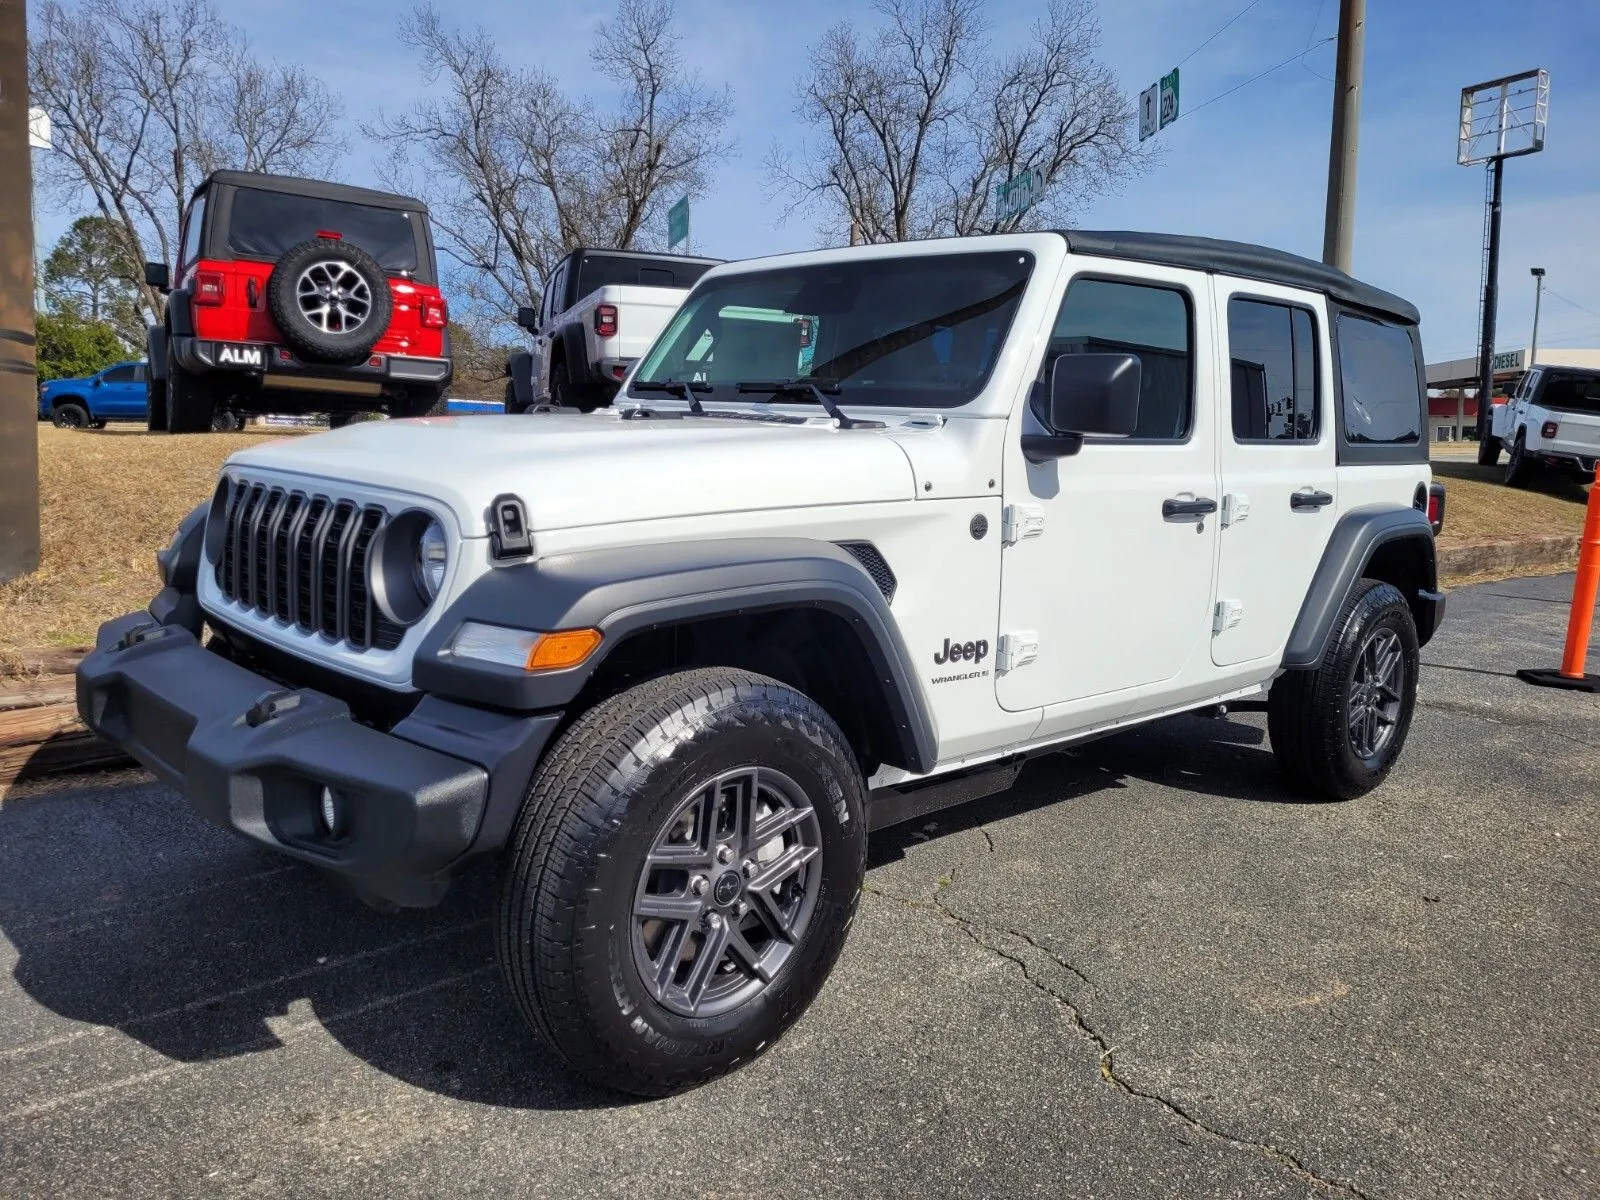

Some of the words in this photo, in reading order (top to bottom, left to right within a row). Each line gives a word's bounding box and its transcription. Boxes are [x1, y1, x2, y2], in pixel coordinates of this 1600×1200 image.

[219, 347, 261, 365] ALM
[1494, 352, 1520, 369] DIESEL
[933, 637, 989, 665] Jeep
[930, 671, 981, 685] WRANGLER
